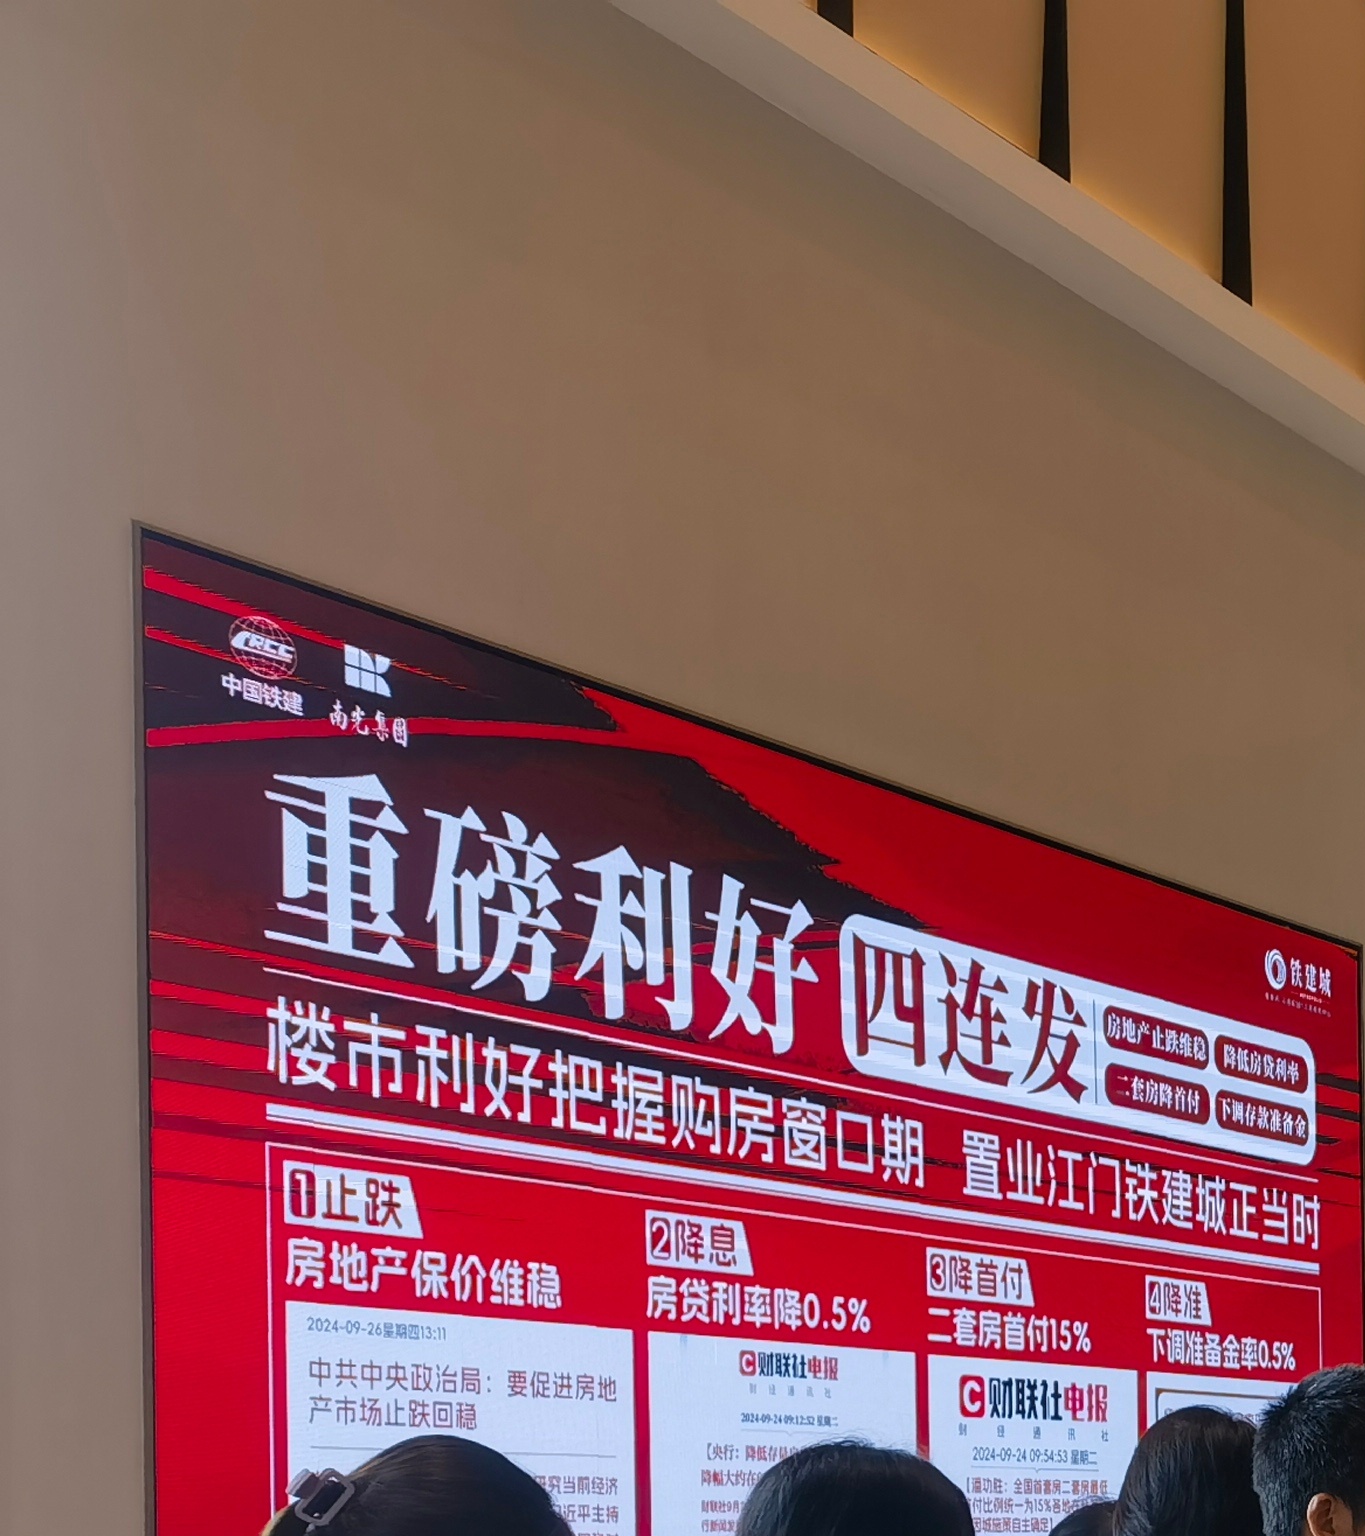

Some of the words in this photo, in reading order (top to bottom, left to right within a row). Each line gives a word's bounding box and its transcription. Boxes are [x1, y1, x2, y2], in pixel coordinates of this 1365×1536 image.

[220, 672, 304, 716] 中国铁建
[264, 772, 818, 1055] 重磅利好
[850, 930, 1090, 1104] 四连发
[1290, 956, 1332, 998] 铁建城
[1106, 1012, 1207, 1061] 房地产止跌维稳
[1223, 1043, 1300, 1085] 降低房贷利率
[265, 994, 926, 1188] 楼市利好把握购房窗口期
[961, 1129, 1321, 1251] 置业江门铁建城正当时
[1117, 1075, 1200, 1115] 二套房降首付
[1218, 1097, 1307, 1139] 下调存款准备金
[285, 1236, 563, 1310] 房地产保价维稳
[646, 1276, 871, 1333] 房贷利率降0.5%
[927, 1307, 1091, 1353] 二套房首付15%
[1146, 1328, 1296, 1371] 下调准备金率0.5%
[308, 1396, 477, 1432] 产市场止跌回稳
